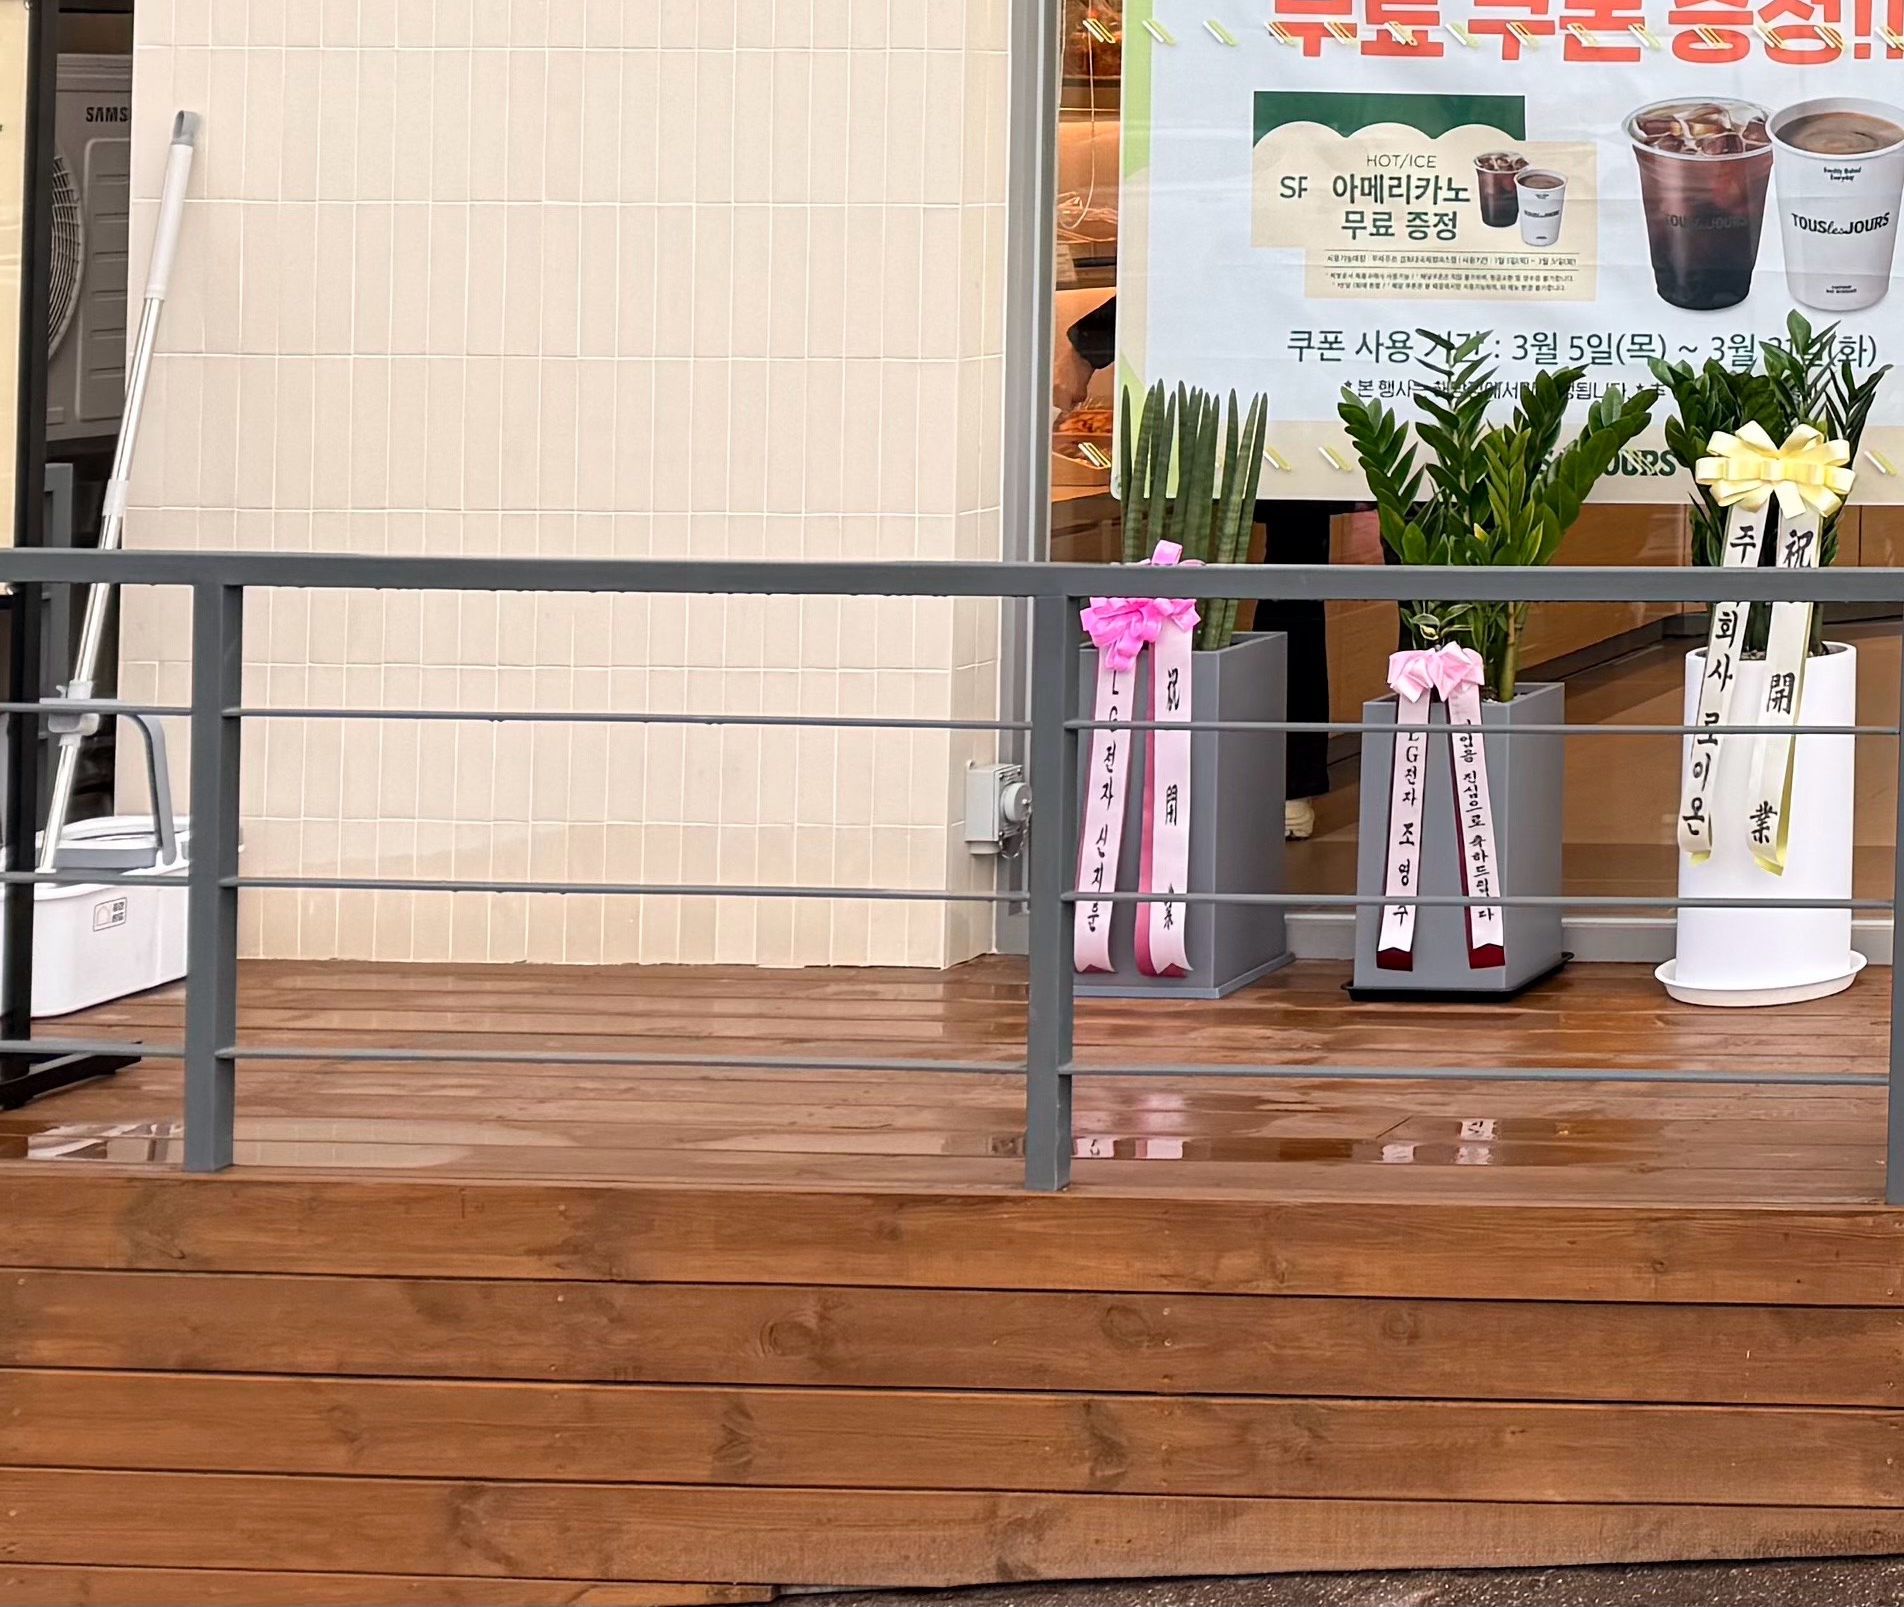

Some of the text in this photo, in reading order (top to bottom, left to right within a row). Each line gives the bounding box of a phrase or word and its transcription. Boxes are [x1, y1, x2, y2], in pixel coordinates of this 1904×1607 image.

[85, 105, 130, 125] SAMS
[1366, 153, 1438, 170] HOT/ICE
[1332, 173, 1471, 206] 아메리카노
[1341, 210, 1459, 241] 무료 증정
[1287, 330, 1345, 362] 쿠폰
[1355, 329, 1415, 364] 사용
[1512, 331, 1559, 365] 3월
[1569, 333, 1667, 366] 5일(목)
[1711, 333, 1757, 366] 3월
[1708, 525, 1757, 692] 주회사
